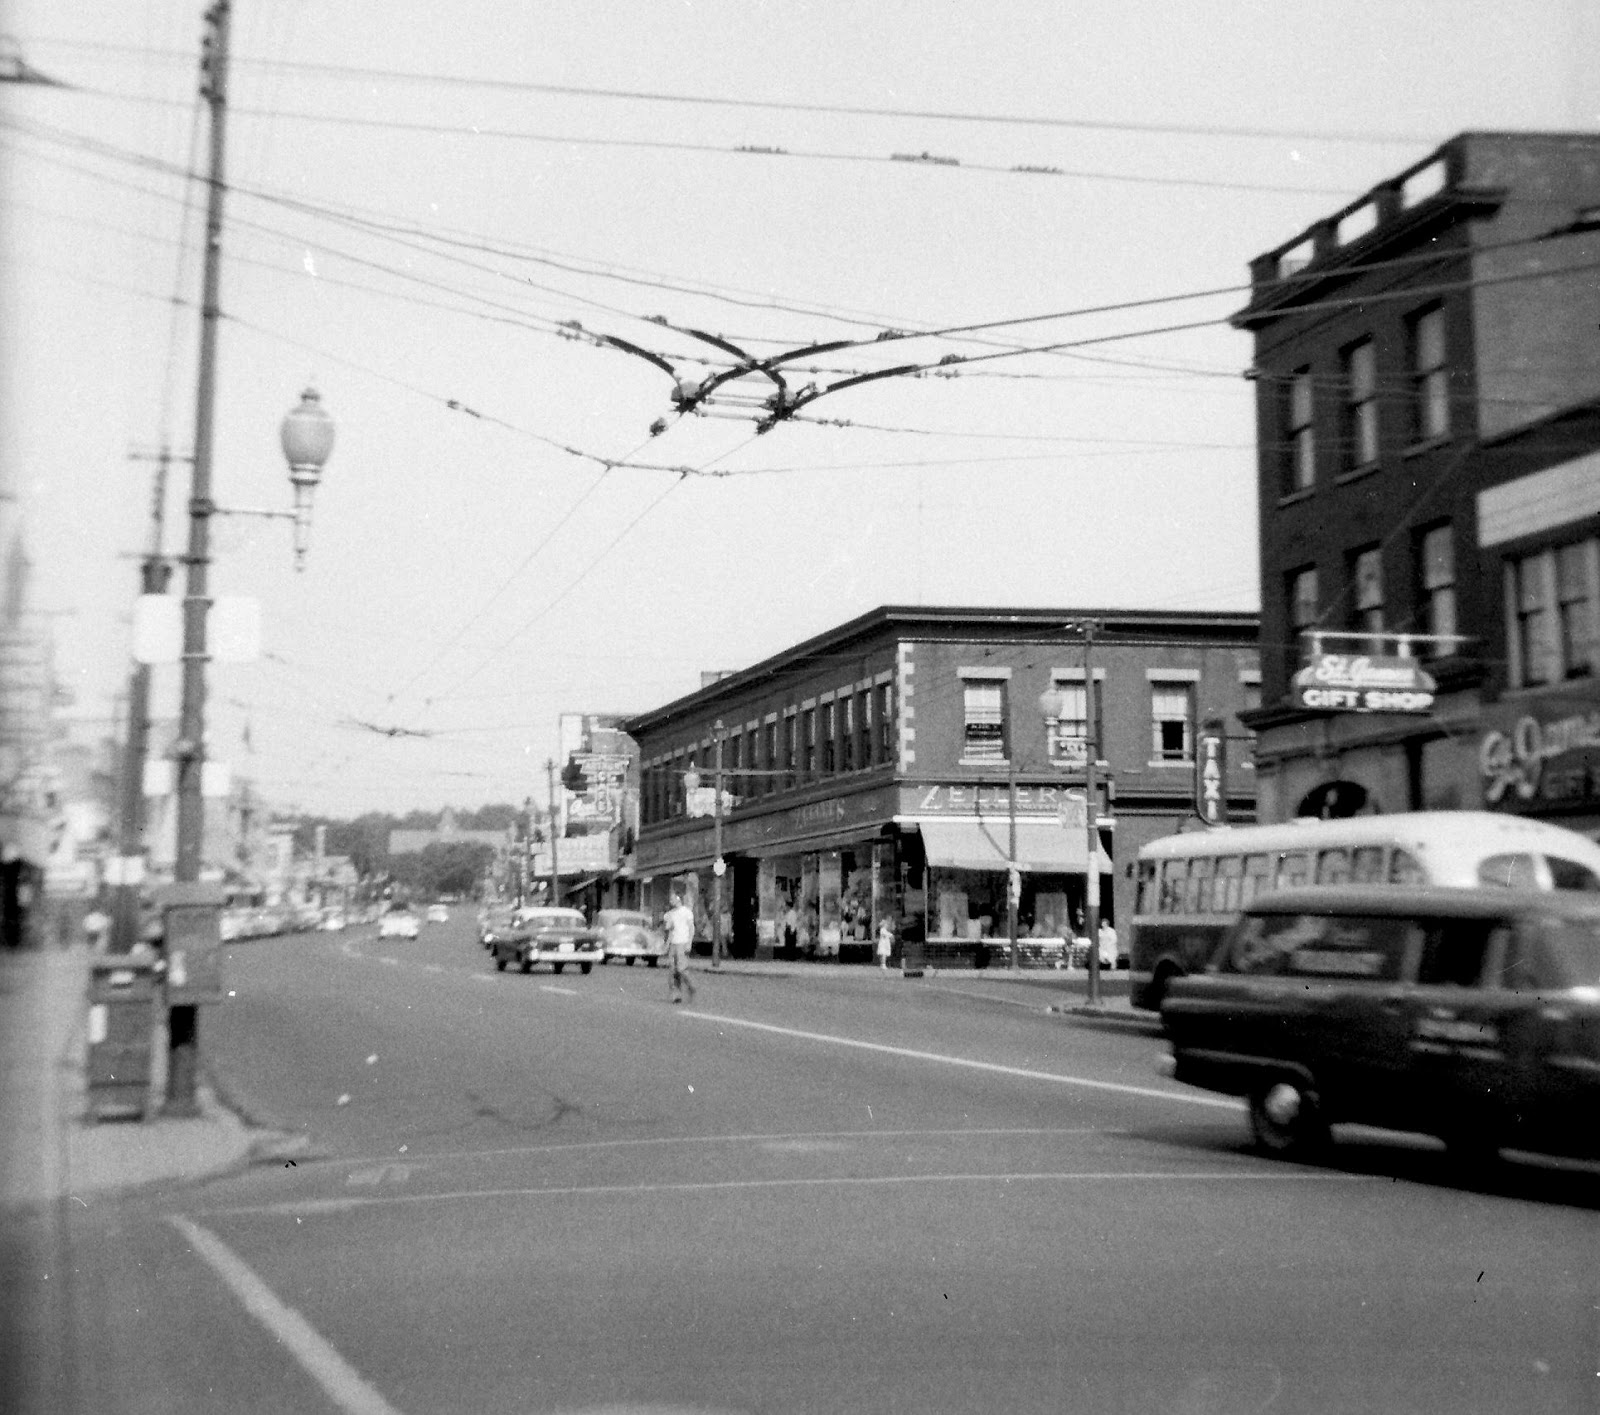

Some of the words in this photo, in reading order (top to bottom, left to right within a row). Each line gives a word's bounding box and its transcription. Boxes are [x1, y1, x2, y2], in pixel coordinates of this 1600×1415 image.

[1302, 689, 1359, 707] GIFT
[1364, 691, 1435, 710] SHOP
[1203, 737, 1221, 820] TAXI
[917, 784, 1088, 810] ZELLERS
